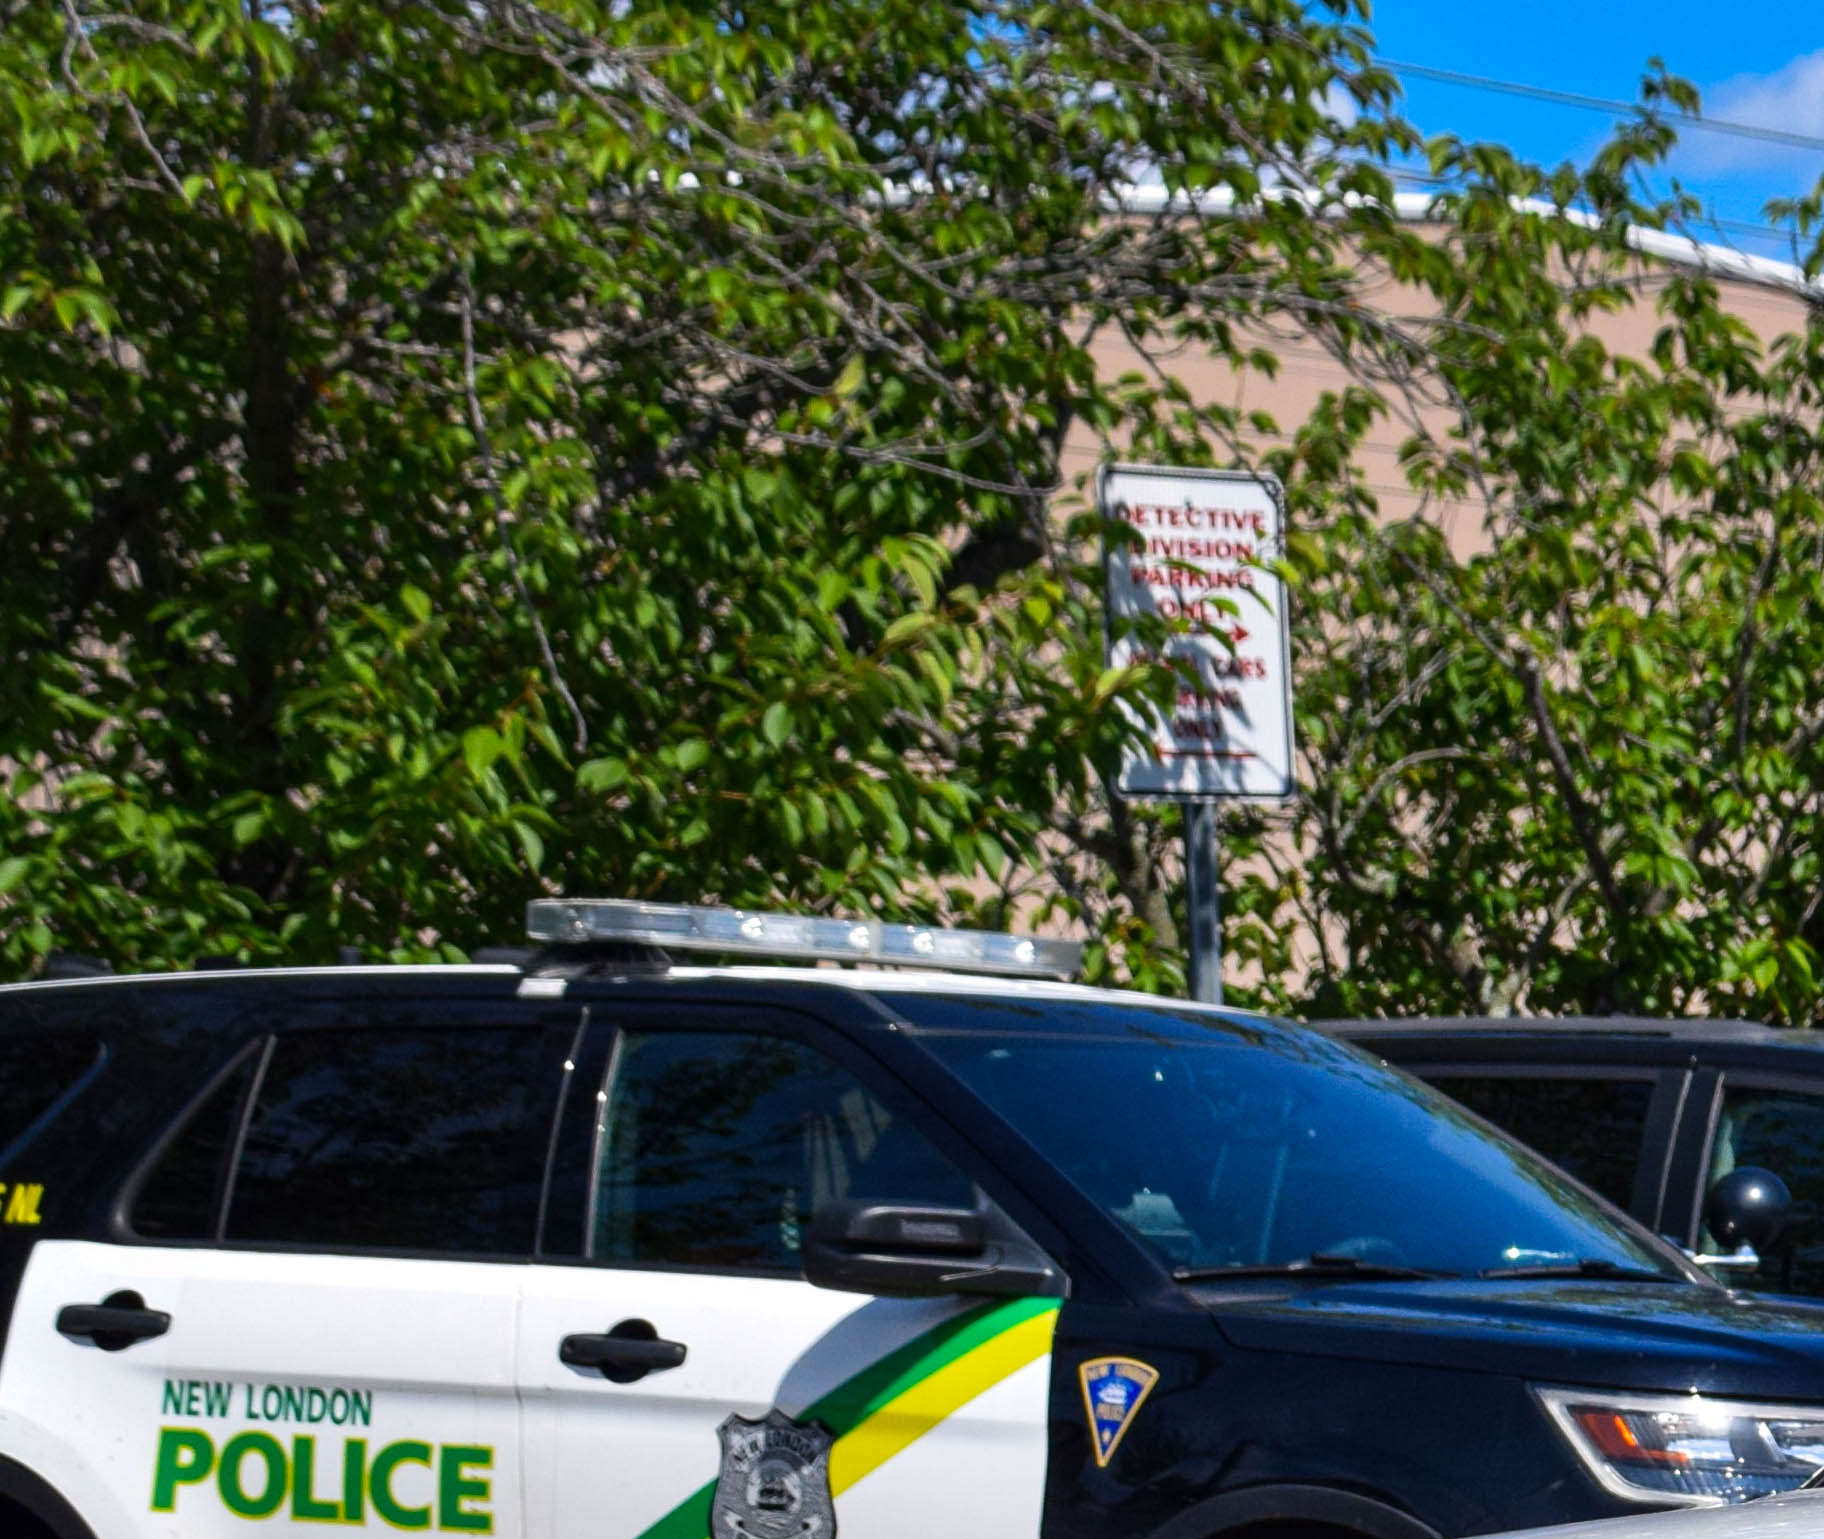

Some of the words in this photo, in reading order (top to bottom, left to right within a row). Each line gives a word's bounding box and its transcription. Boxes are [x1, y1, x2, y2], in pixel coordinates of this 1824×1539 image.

[1115, 503, 1265, 530] DETECTIVE
[1131, 565, 1256, 592] PARKING
[4, 1183, 44, 1224] NL
[163, 1379, 233, 1419] NEW
[246, 1384, 373, 1427] LONDON
[149, 1425, 495, 1536] POLICE
